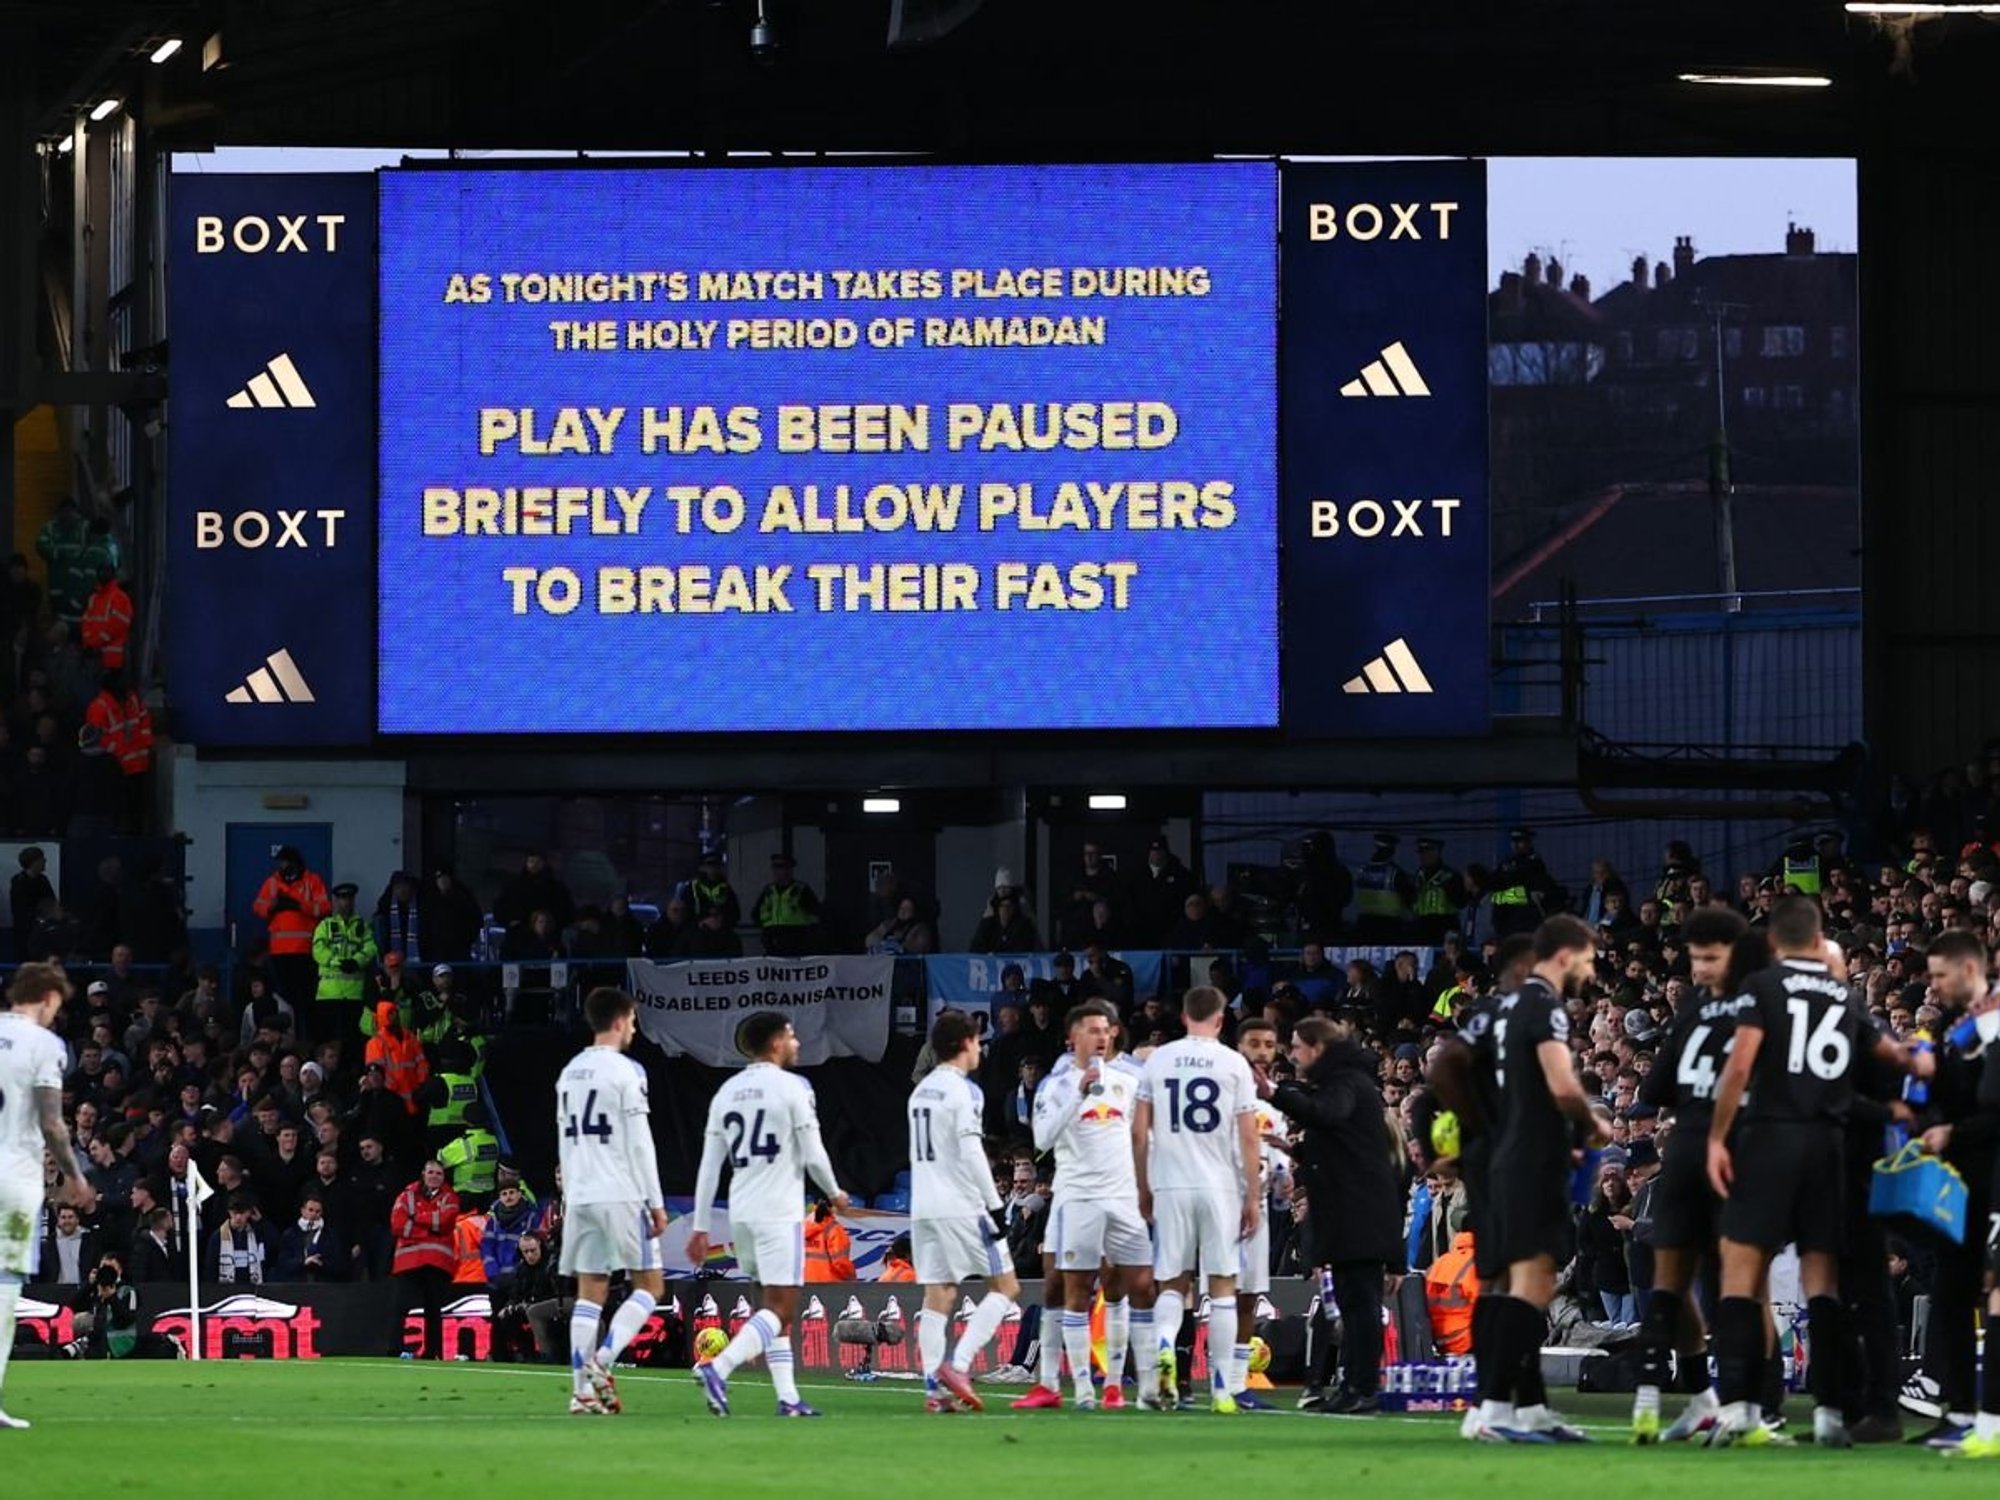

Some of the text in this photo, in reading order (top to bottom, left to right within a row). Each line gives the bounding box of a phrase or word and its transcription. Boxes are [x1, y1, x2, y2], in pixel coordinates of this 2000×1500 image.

[196, 214, 345, 253] BOXT
[1309, 202, 1459, 241] BOXT
[446, 267, 1210, 302] AS TONIGHT'S MATCH TAKES PLACE DURING
[550, 317, 1104, 349] THE HOLY PERIOD OF RAMADAN
[480, 402, 1177, 454] PLAY HAS BEEN PAUSED
[423, 481, 1236, 535] BRIEFLY TO ALLOW PLAYERS
[1311, 499, 1461, 538] BOXT
[196, 509, 345, 549] BOXT
[503, 562, 1138, 614] TO BREAK THEIR FAST
[687, 964, 829, 987] LEEDS UNITED
[634, 983, 884, 1012] DISABLED ORGANISATION
[1787, 998, 1850, 1081] 16
[1174, 1056, 1214, 1069] STACH
[1163, 1077, 1221, 1133] 18
[723, 1108, 781, 1168] 24
[912, 1107, 936, 1162] 11
